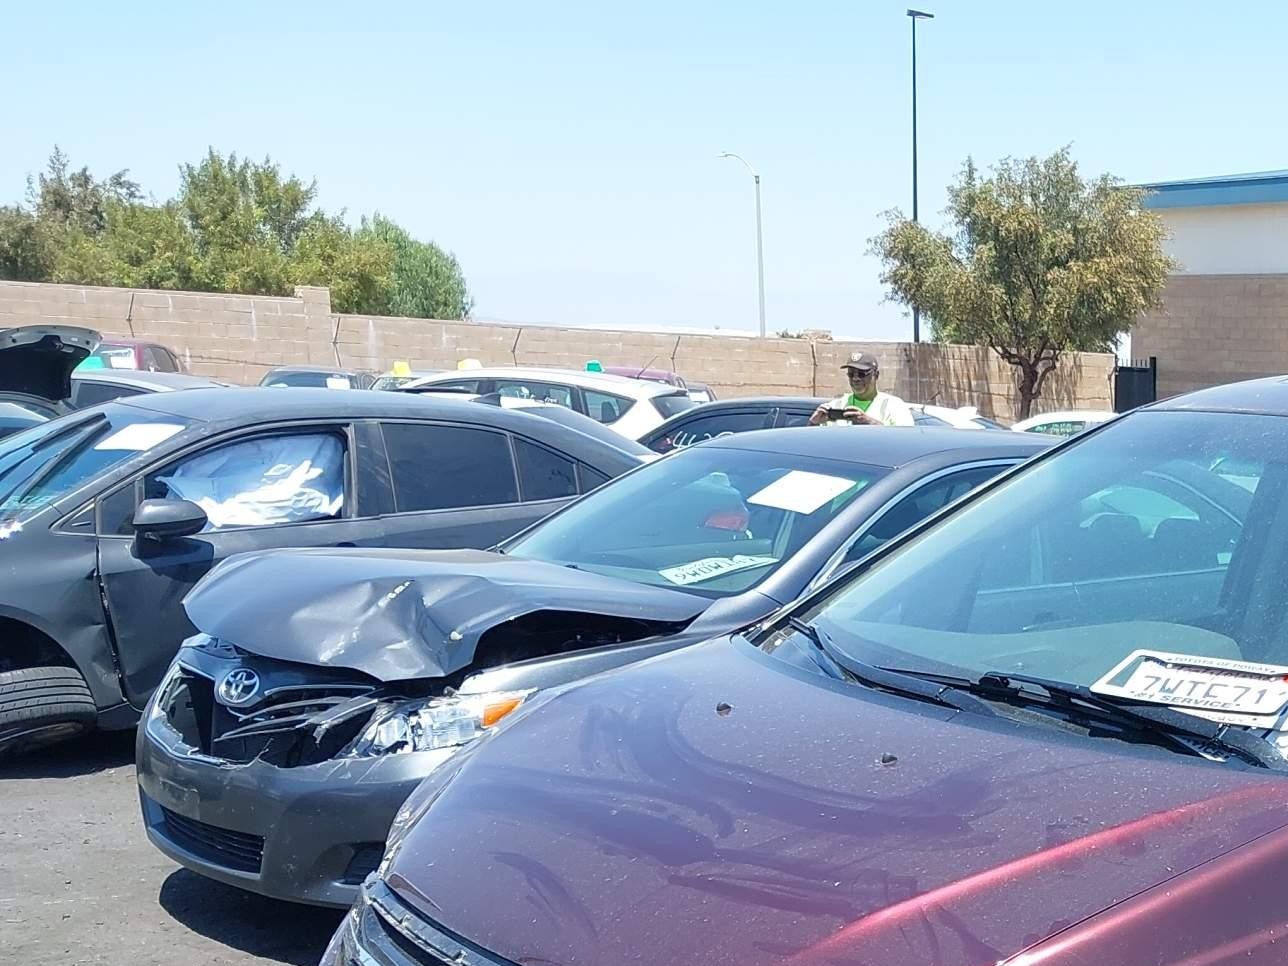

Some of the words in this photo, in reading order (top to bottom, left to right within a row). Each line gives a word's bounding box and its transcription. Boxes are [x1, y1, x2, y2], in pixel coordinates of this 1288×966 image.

[1174, 656, 1214, 666] TOYOTA
[1215, 660, 1231, 668] OF
[1160, 695, 1233, 708] SERVICE
